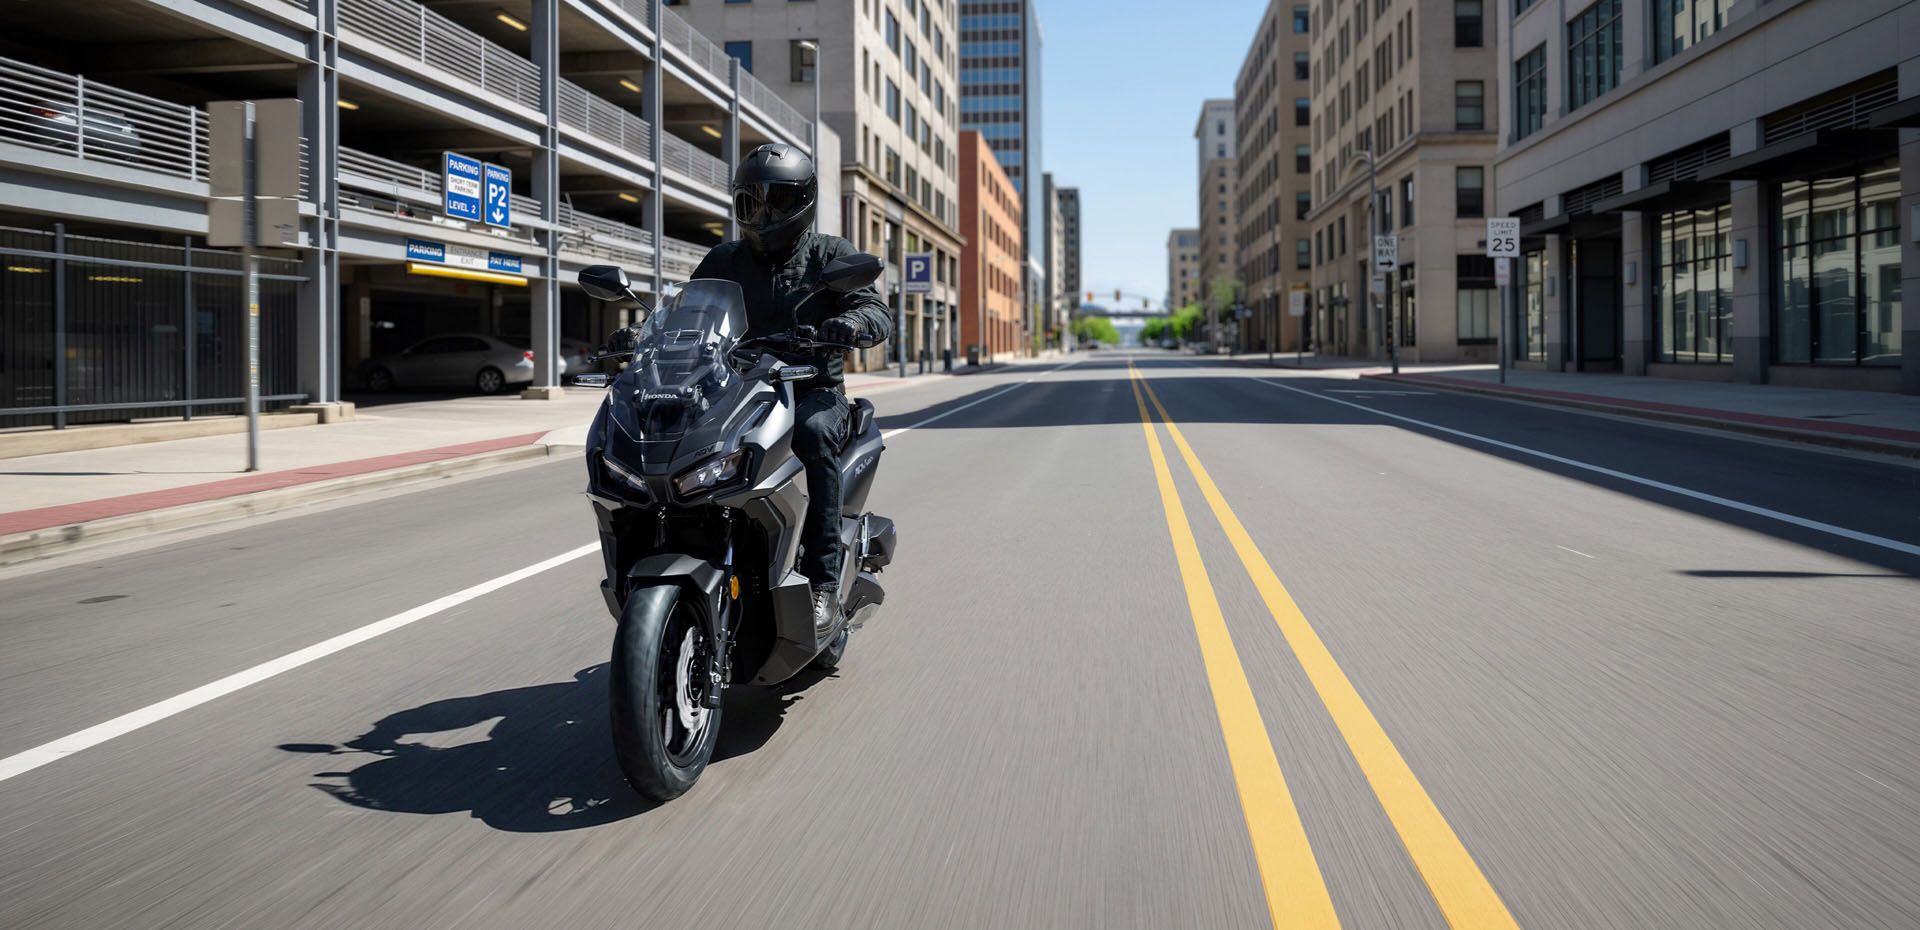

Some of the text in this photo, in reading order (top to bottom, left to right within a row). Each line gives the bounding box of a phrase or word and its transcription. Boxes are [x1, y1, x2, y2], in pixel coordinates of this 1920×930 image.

[449, 159, 478, 175] PARKING
[487, 168, 509, 182] PARKING
[454, 185, 474, 195] PARKING
[489, 183, 507, 208] P2
[449, 200, 477, 214] LEVEL 2
[1378, 238, 1395, 247] ONE
[1492, 238, 1515, 252] 25
[409, 244, 443, 257] PARKING
[1378, 249, 1395, 257] WAY
[490, 256, 520, 268] PAY HERE
[911, 260, 925, 280] P
[694, 445, 714, 457] ADV
